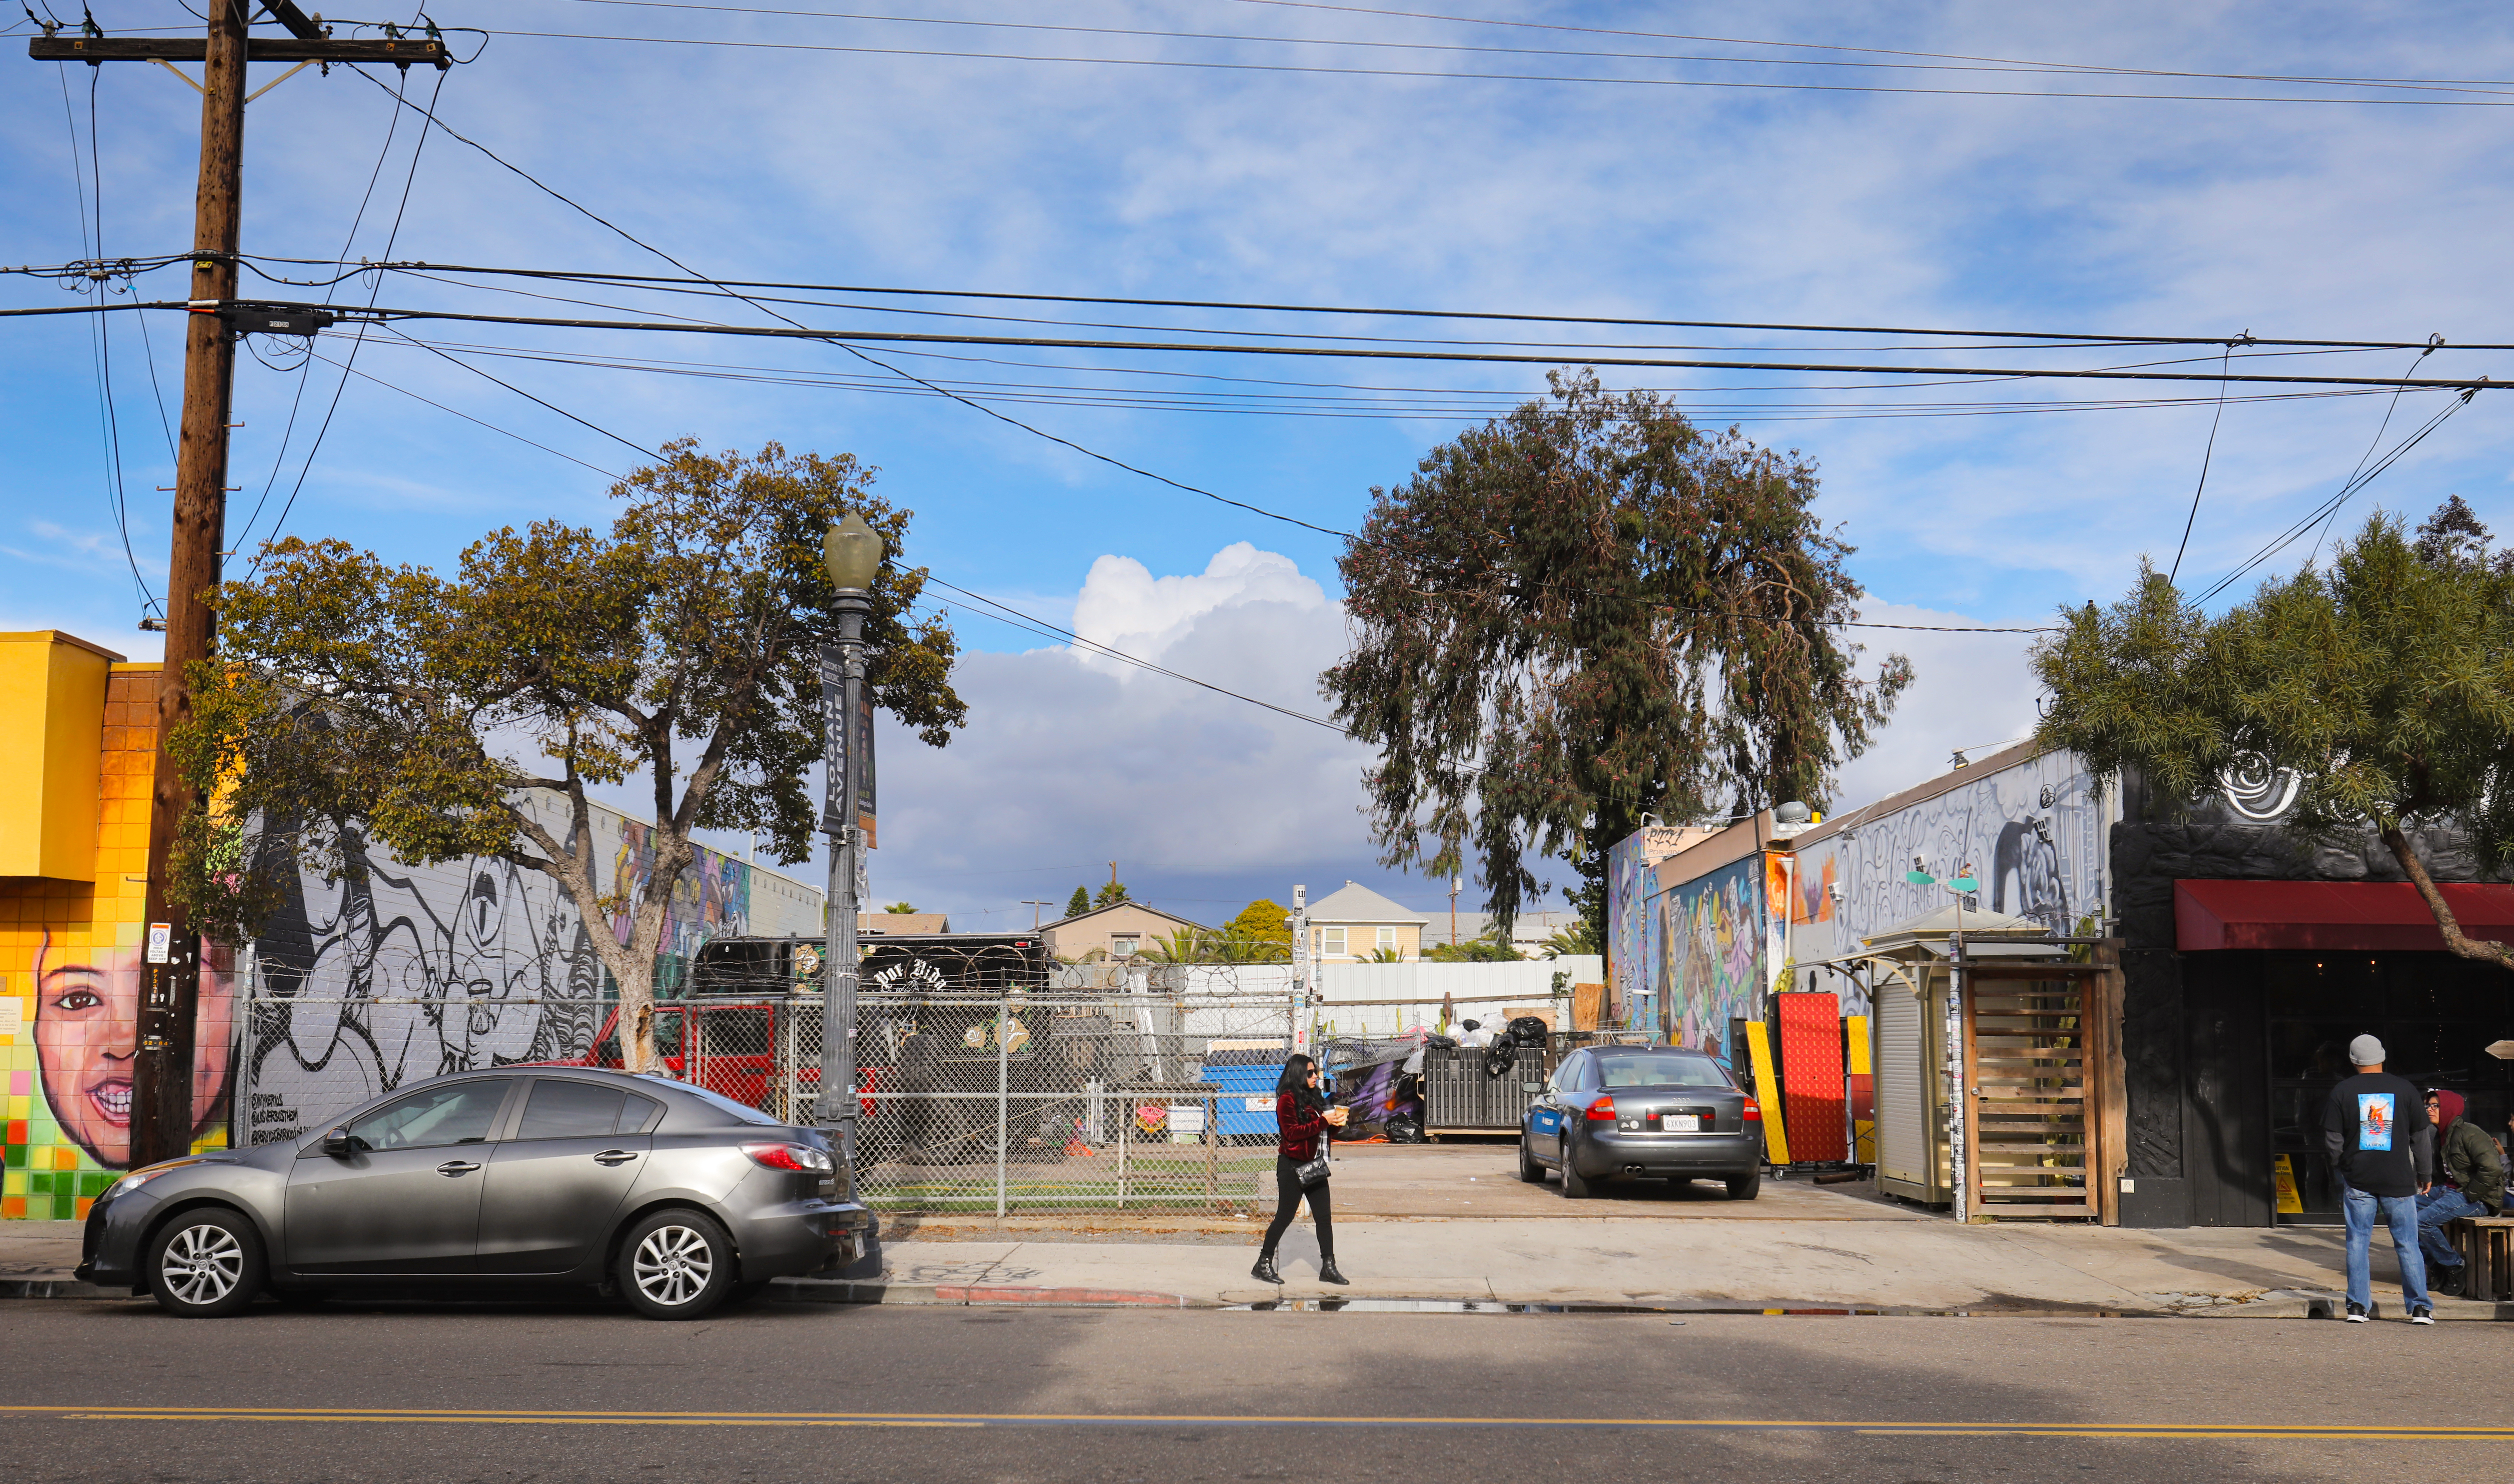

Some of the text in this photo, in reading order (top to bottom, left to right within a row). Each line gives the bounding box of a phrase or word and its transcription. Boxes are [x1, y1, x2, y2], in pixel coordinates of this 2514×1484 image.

[822, 660, 843, 674] WELCOME TO
[824, 670, 840, 683] HISTORIC
[825, 700, 835, 801] LOGAN
[834, 693, 843, 814] AVENUE
[873, 963, 904, 992] Por
[1666, 1120, 1696, 1128] 6XKN903
